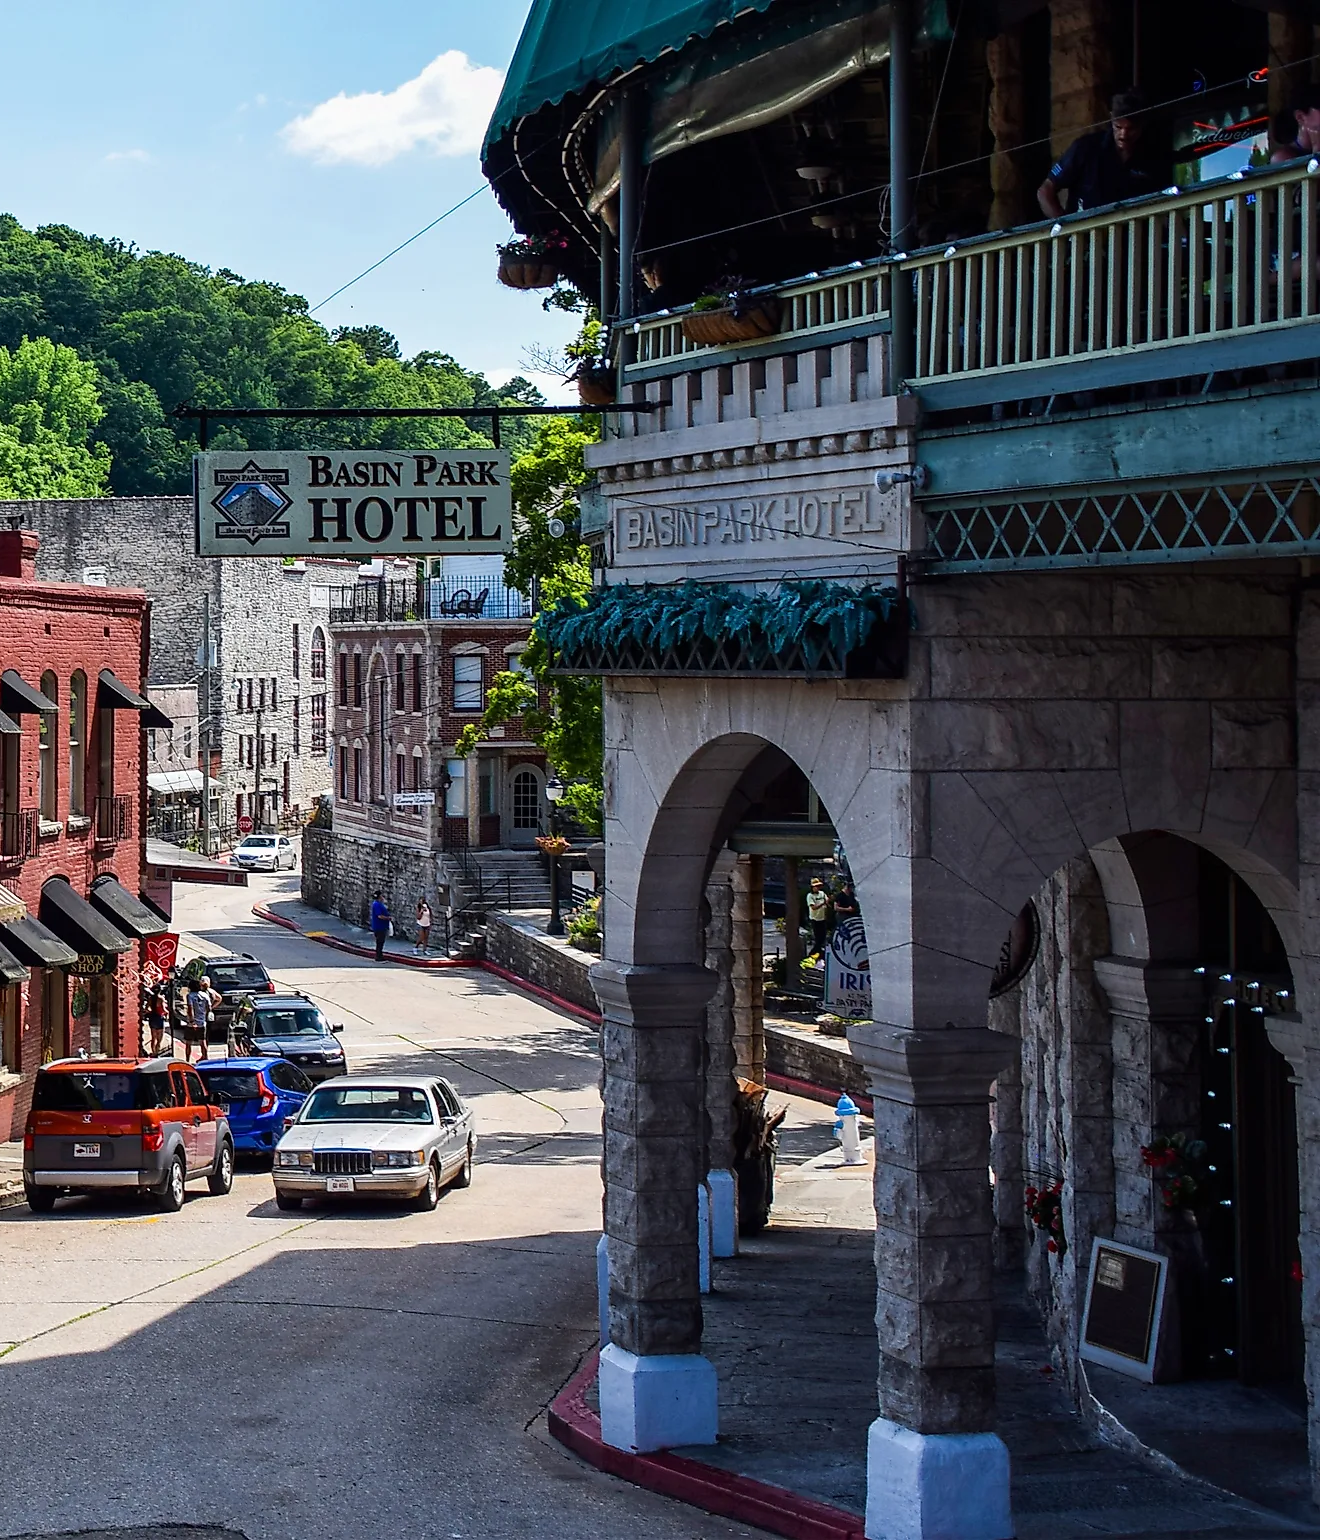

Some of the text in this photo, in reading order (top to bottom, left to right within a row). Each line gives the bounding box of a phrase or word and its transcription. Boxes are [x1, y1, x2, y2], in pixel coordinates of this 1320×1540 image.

[308, 496, 502, 542] HOTEL
[627, 490, 884, 549] BASIN PARK HOTEL
[240, 820, 252, 829] STOP
[71, 963, 103, 973] SHOP
